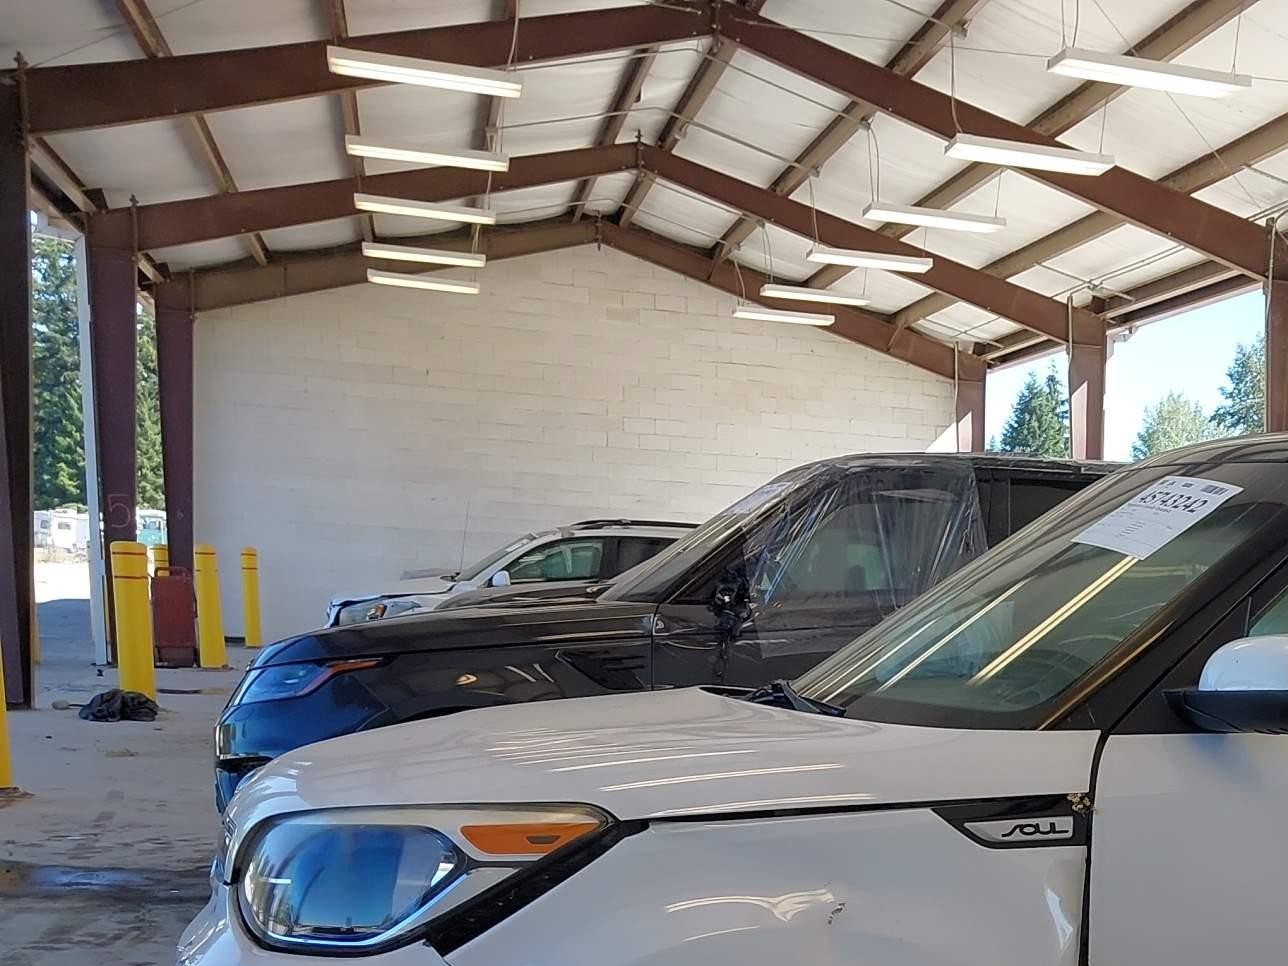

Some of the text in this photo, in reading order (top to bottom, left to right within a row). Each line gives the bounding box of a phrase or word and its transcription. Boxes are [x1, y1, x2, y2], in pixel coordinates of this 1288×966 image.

[107, 493, 131, 527] 5
[1138, 490, 1209, 513] 45743242
[1001, 821, 1069, 838] SOUL
